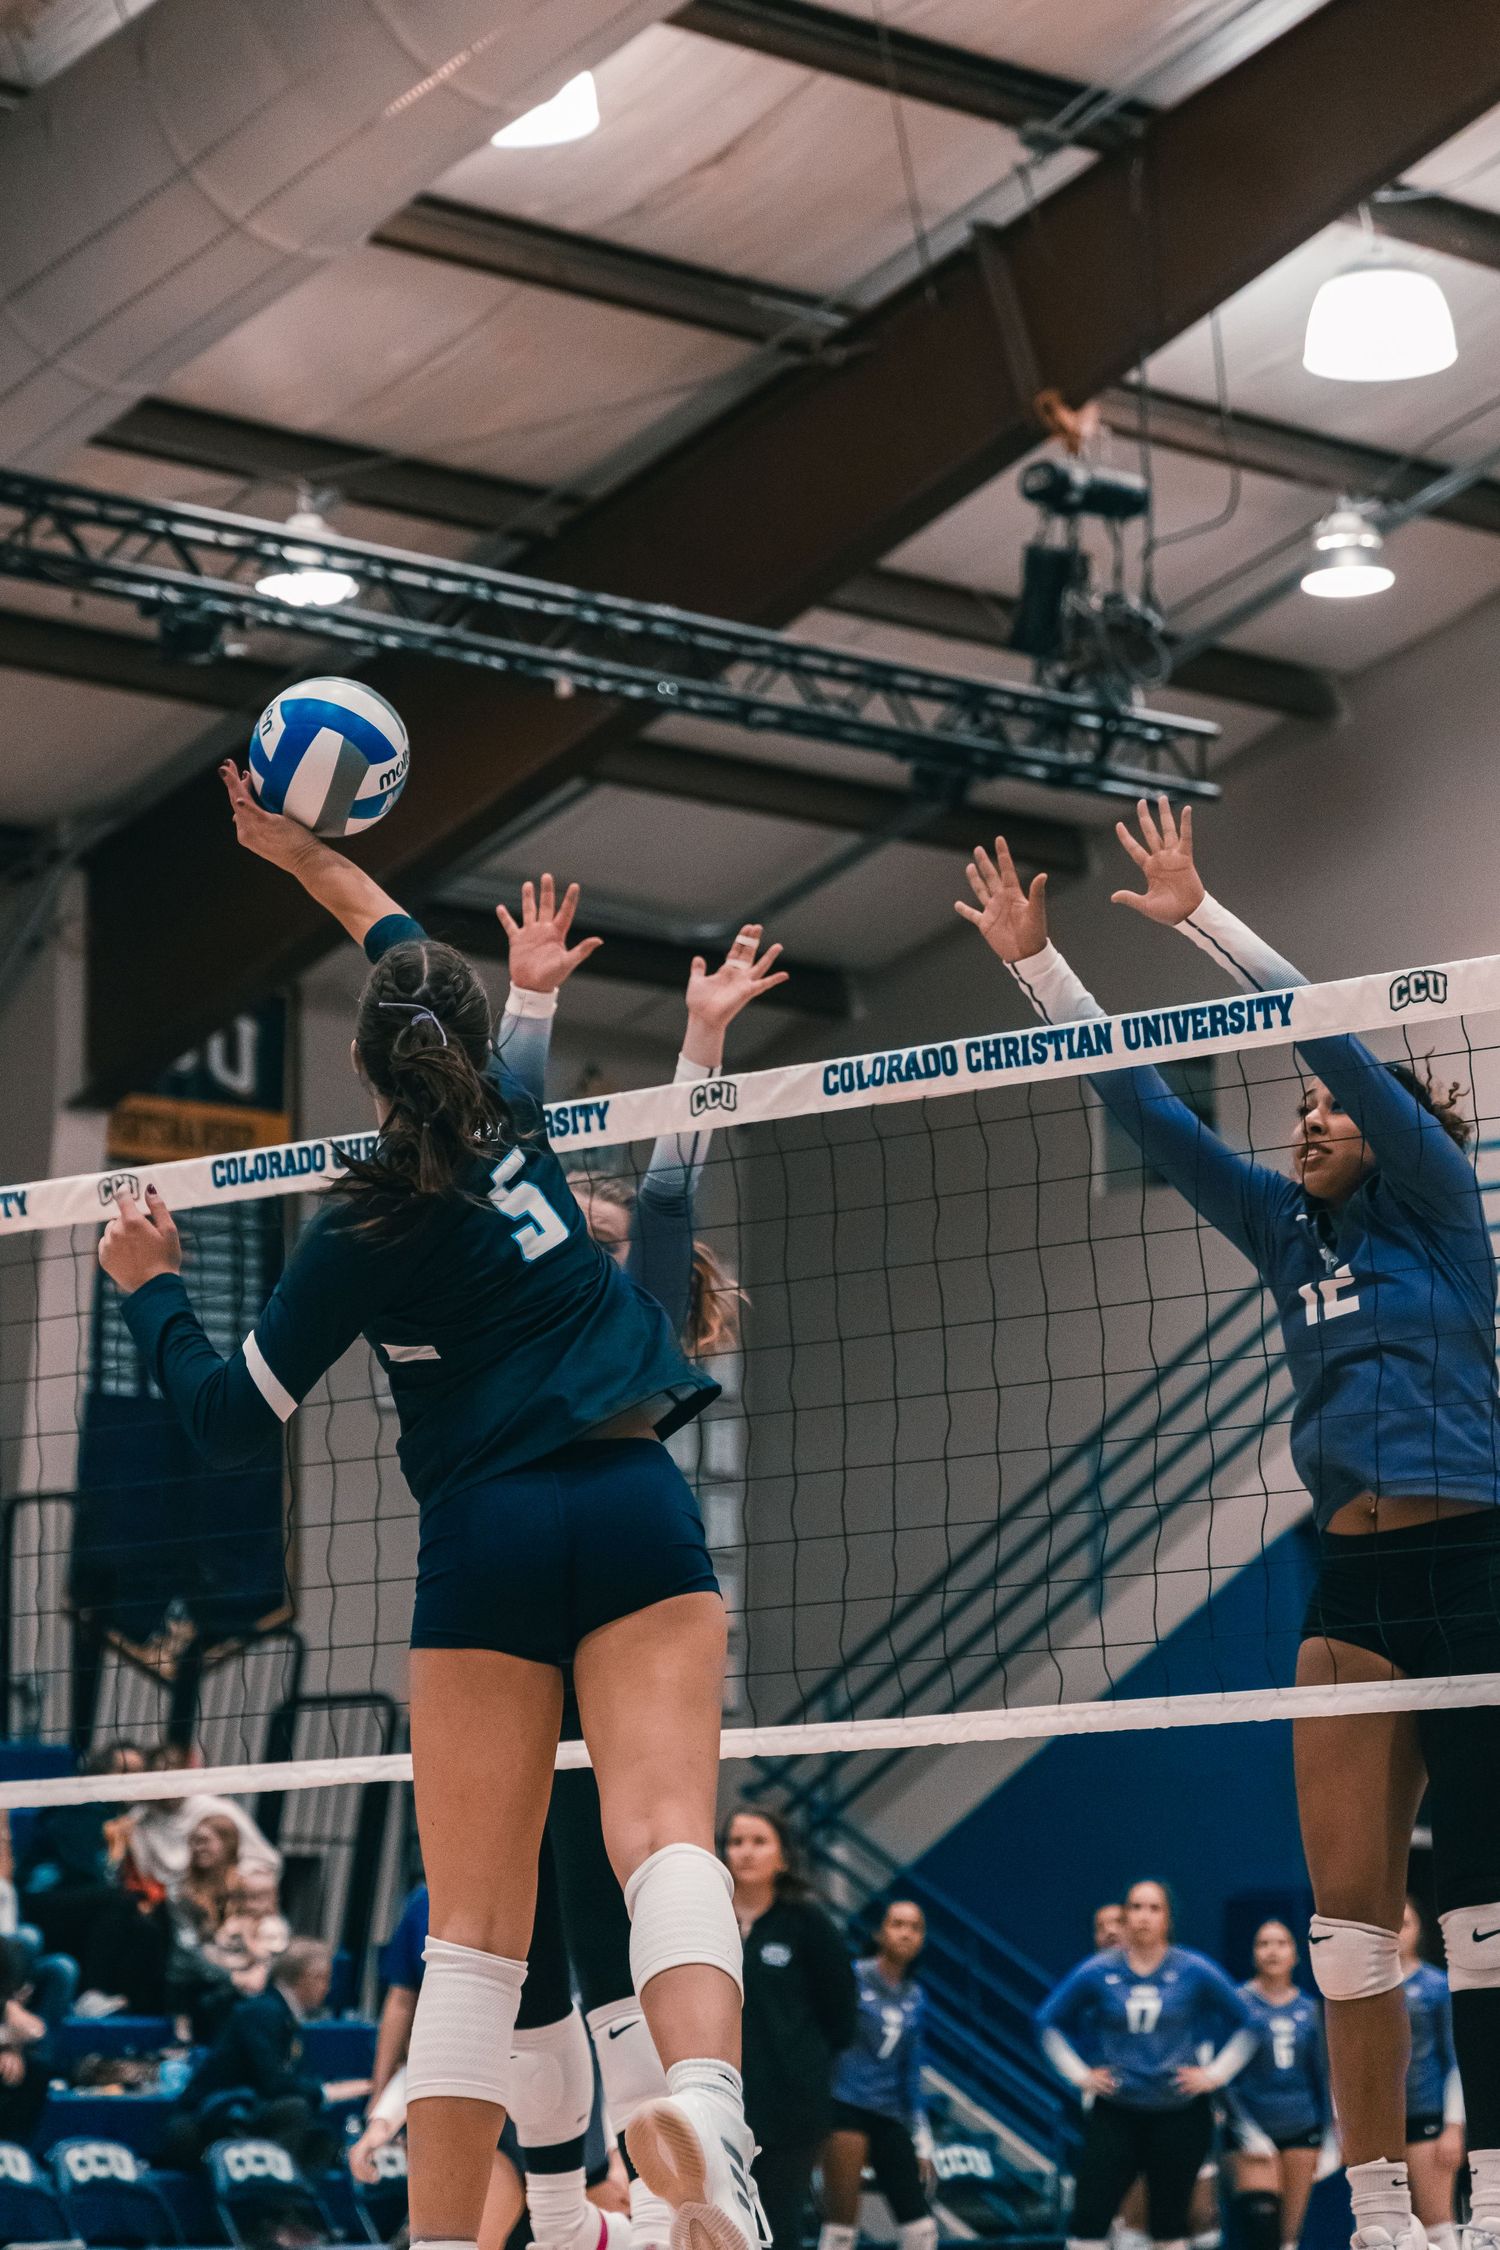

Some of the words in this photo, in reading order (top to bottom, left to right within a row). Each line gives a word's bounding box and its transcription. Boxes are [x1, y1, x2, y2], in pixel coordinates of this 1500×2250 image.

[1390, 970, 1447, 1011] CCU
[822, 1045, 958, 1096] COLORADO
[966, 1022, 1113, 1073] CHRISTIAN
[1121, 993, 1294, 1051] UNIVERSITY
[690, 1081, 737, 1117] CCU
[211, 1143, 325, 1188] COLORADO
[488, 1146, 569, 1262] 5
